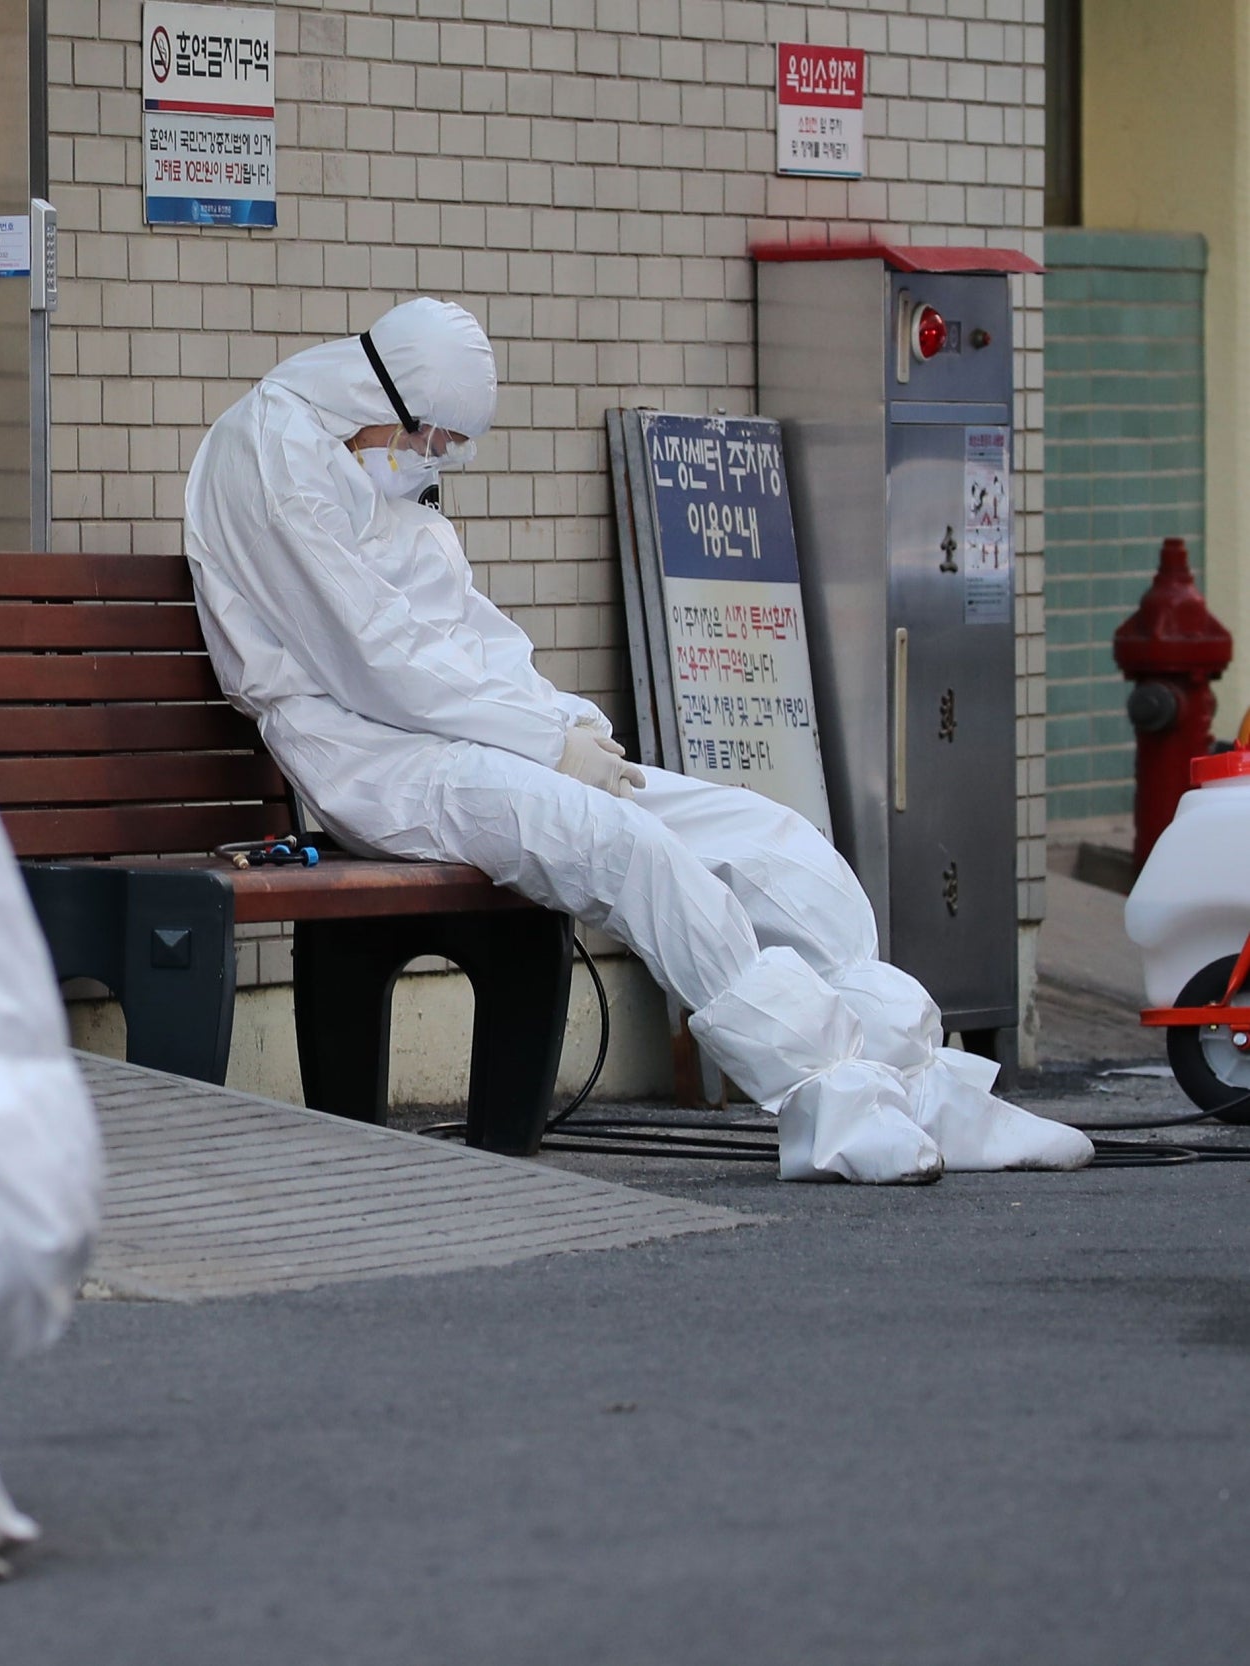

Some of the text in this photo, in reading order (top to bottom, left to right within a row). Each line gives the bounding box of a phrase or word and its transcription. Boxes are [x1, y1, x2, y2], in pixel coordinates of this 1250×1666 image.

[176, 30, 269, 82] 흡연금지구역
[786, 55, 856, 95] 옥외소화전
[149, 127, 272, 157] 흡연시 국민건강증진법에 의거
[154, 159, 271, 185] 과태료 10만원이 부과됩니다.
[653, 435, 781, 497] 신장센터 주차장
[687, 502, 761, 559] 이용안내
[673, 605, 799, 640] 이 주차장은 신장 투석환자
[677, 646, 778, 684] 전용주차구역입니다.
[682, 694, 810, 728] 교직원 차량 및 고객 차량의
[688, 739, 774, 770] 주차를 금지합니다.
